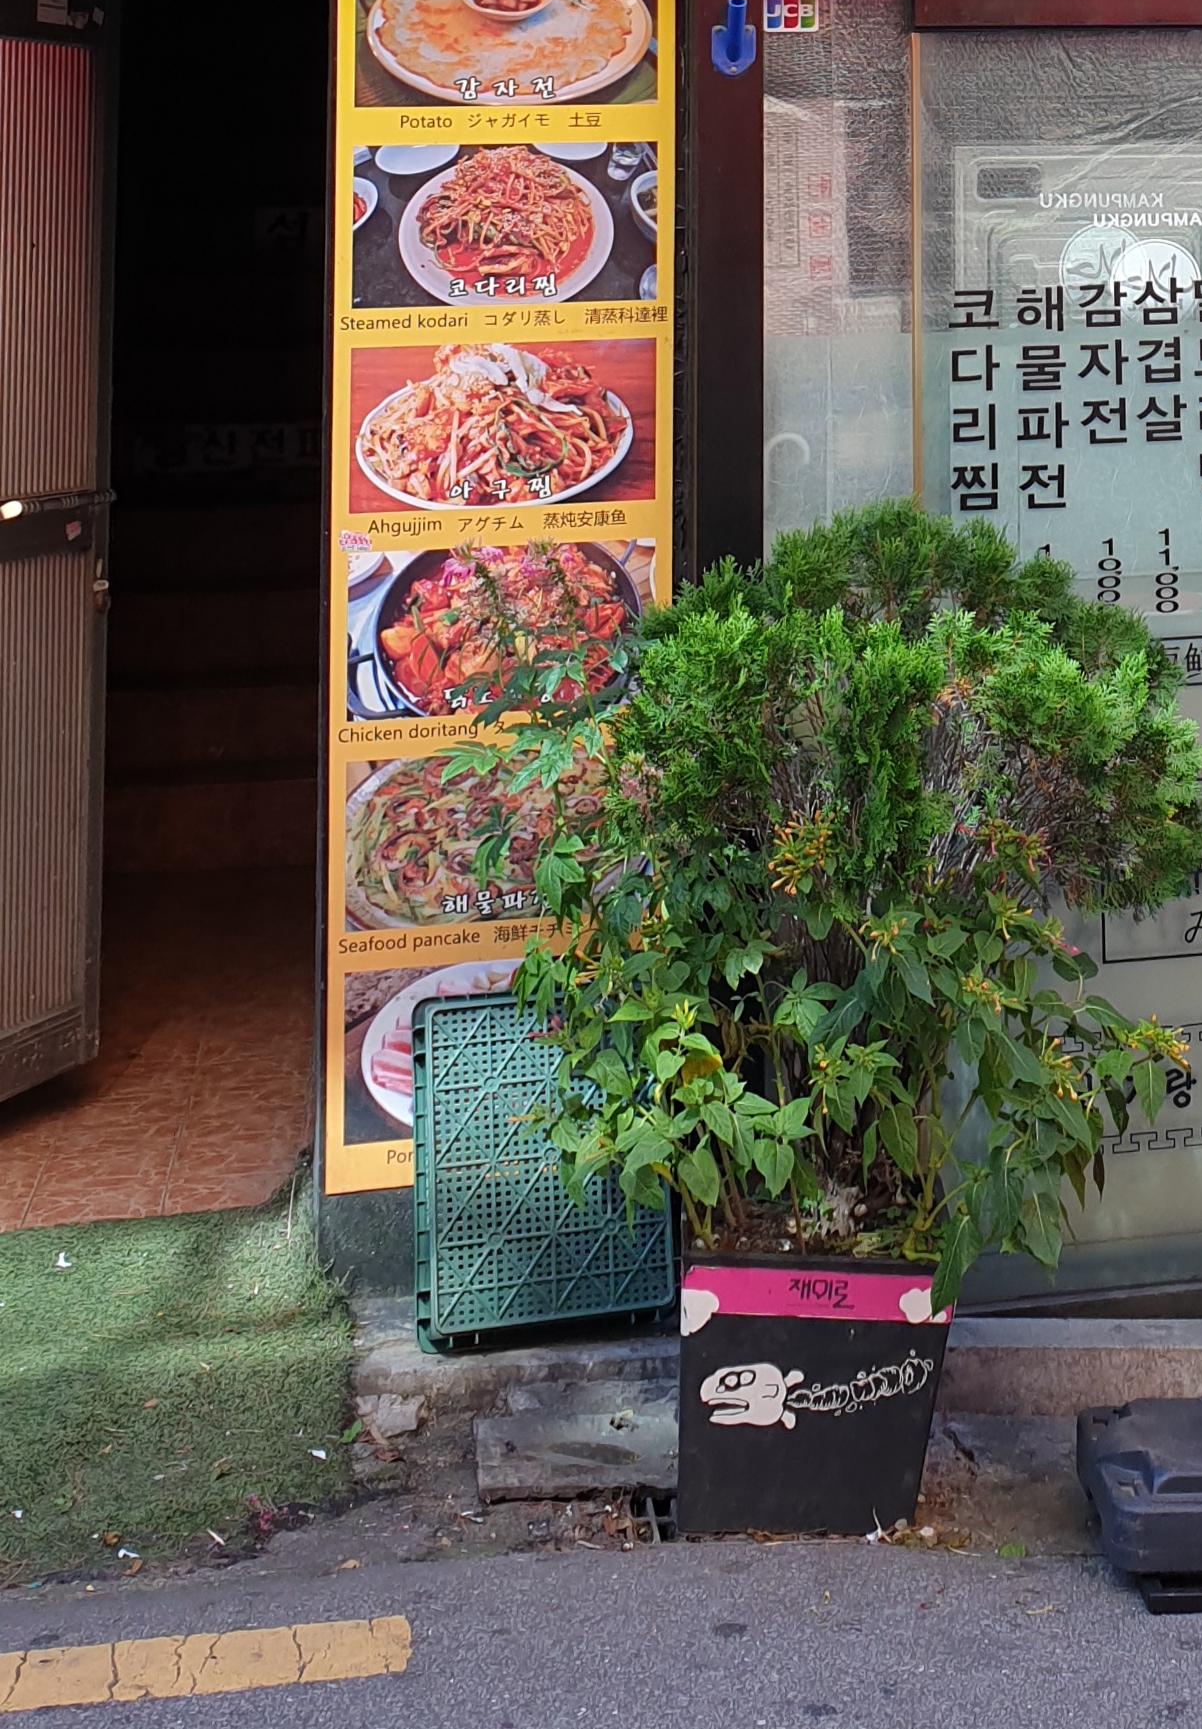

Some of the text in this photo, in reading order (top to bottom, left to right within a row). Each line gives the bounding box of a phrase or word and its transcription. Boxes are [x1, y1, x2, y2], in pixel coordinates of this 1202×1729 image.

[766, 3, 815, 19] JCB
[400, 112, 602, 129] Potato ジャガイモ 土豆
[448, 275, 558, 298] 코다리찜
[339, 315, 412, 331] Steamed
[417, 312, 469, 329] kodari
[1077, 281, 1130, 444] 감자전
[1132, 278, 1188, 442] 삼겹살
[948, 288, 1003, 511] 코다리찜
[1015, 286, 1069, 509] 해물파전
[448, 475, 553, 501] 아구찜
[366, 517, 443, 536] Ahgujjim
[338, 726, 403, 743] Chicken
[409, 722, 479, 740] doritang
[338, 934, 407, 954] Seafood
[412, 929, 481, 952] pancake
[386, 1148, 413, 1165] Por
[788, 1277, 854, 1310] 재미로
